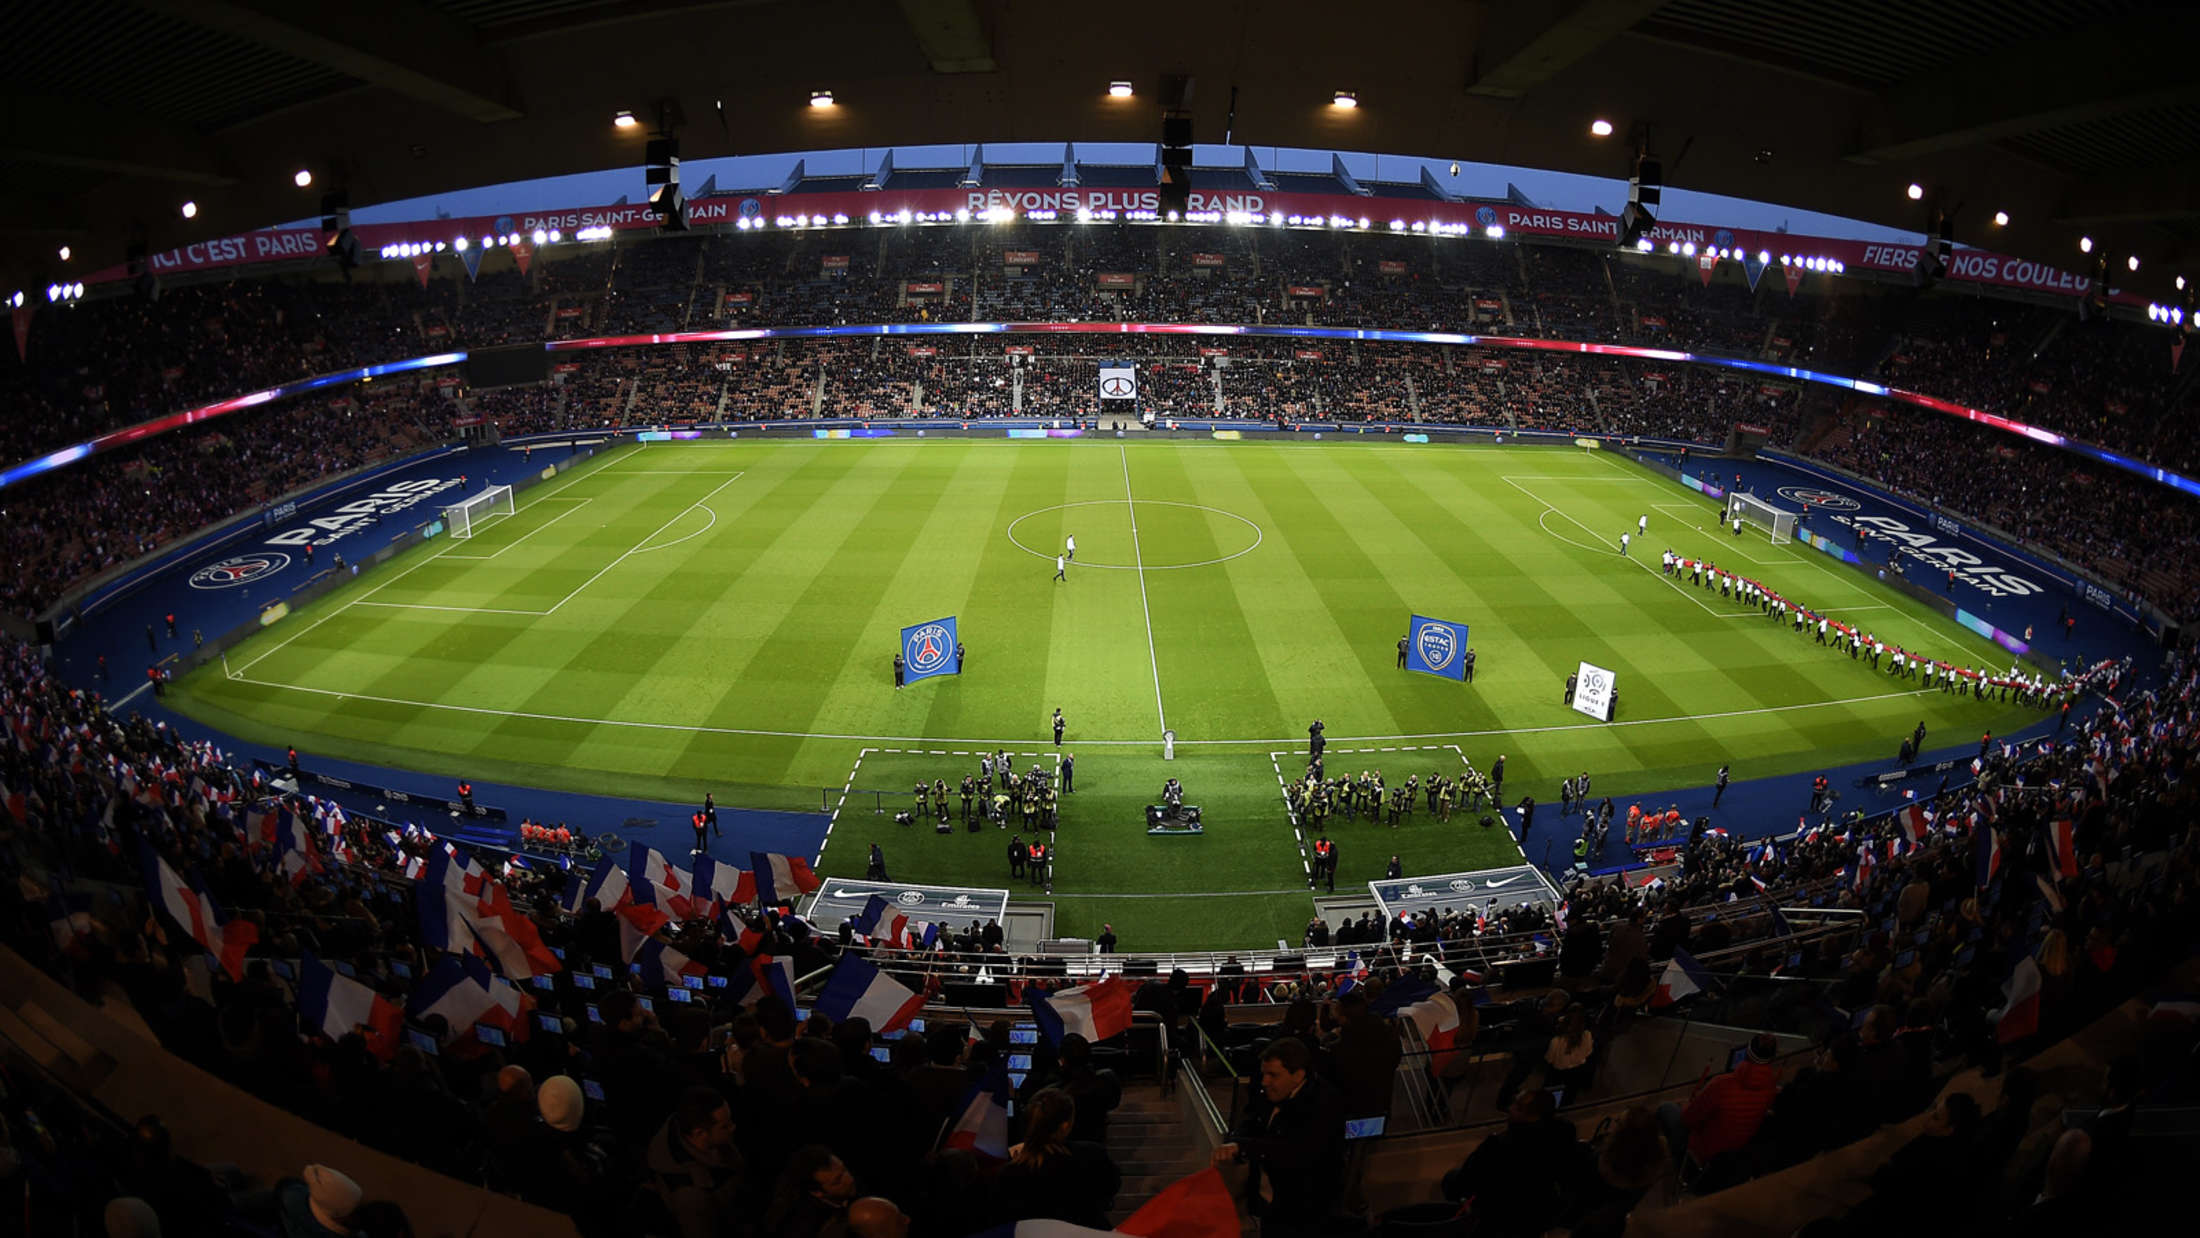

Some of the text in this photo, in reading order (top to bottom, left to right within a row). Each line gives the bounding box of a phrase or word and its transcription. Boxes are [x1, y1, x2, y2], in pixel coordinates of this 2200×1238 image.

[967, 189, 1264, 212] RÊVONS PLUS RAND
[524, 213, 577, 230] PARIS
[1509, 213, 1563, 229] PARIS
[188, 237, 246, 263] C'EST
[256, 232, 318, 257] PARIS
[1863, 245, 1919, 268] FIERS
[1952, 255, 1997, 277] NOS
[264, 479, 440, 545] PARIS
[273, 501, 297, 518] PARIS
[1937, 516, 1959, 533] PARIS
[1855, 516, 2044, 596] PARIS
[2086, 584, 2112, 606] PARIS
[913, 627, 943, 642] PARIS
